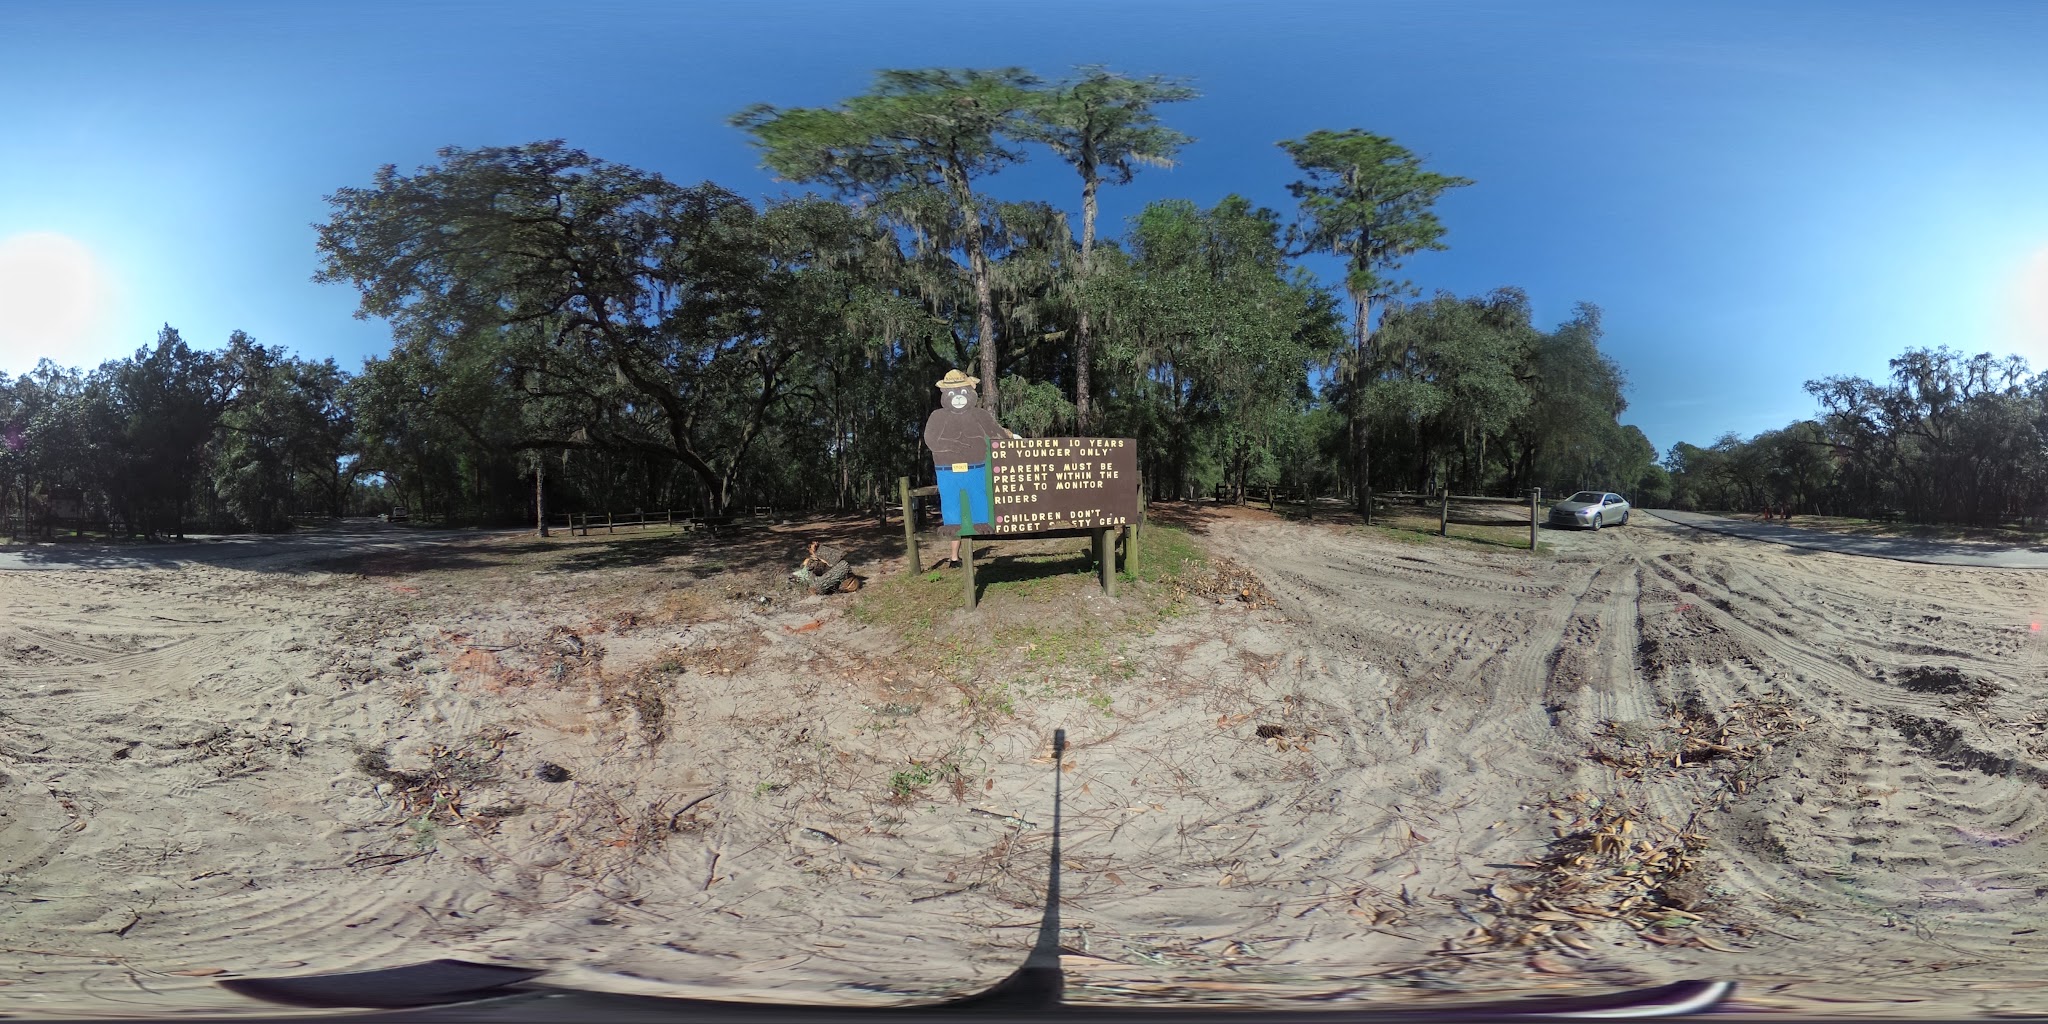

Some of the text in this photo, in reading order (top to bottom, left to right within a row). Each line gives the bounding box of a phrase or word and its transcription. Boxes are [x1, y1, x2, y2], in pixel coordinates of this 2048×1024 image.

[999, 439, 1124, 449] CHILDREN 10 YEARS
[991, 448, 1108, 459] OR YOUNGER ONLY
[1001, 464, 1055, 474] PARENTS
[1063, 462, 1092, 471] MUST
[993, 471, 1119, 483] PRESENT WITHIN THE
[994, 481, 1103, 493] AREA TO MONITOR
[994, 494, 1038, 504] RIDERS
[1003, 509, 1101, 523] CHILDREN DON'T
[995, 517, 1126, 533] FORGET SETY GEAR
